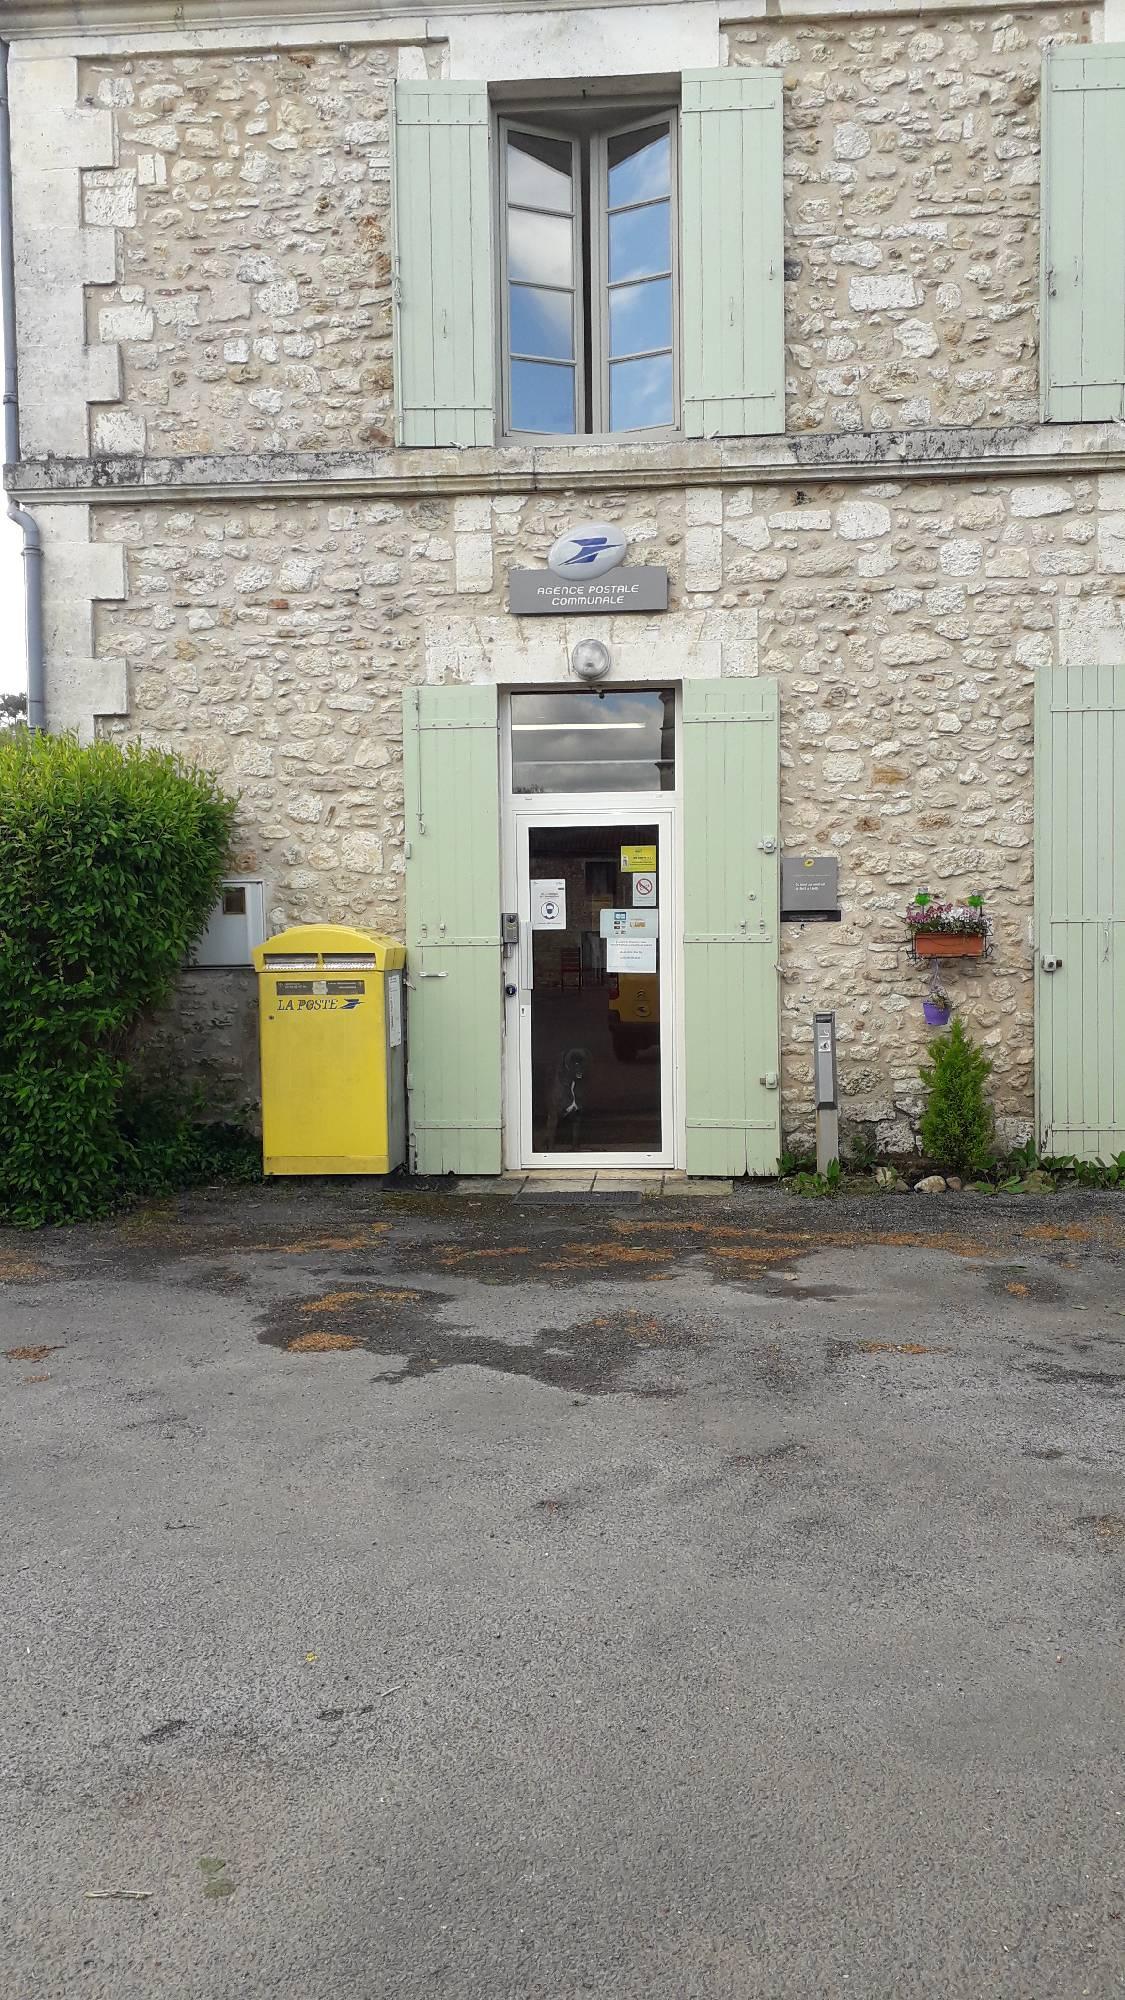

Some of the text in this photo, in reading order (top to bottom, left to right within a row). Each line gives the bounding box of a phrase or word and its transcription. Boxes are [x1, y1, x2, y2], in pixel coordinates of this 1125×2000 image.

[537, 584, 640, 595] AGENCE POSTALE
[552, 595, 625, 606] COMMUNALE
[277, 999, 339, 1010] LA POSTE
